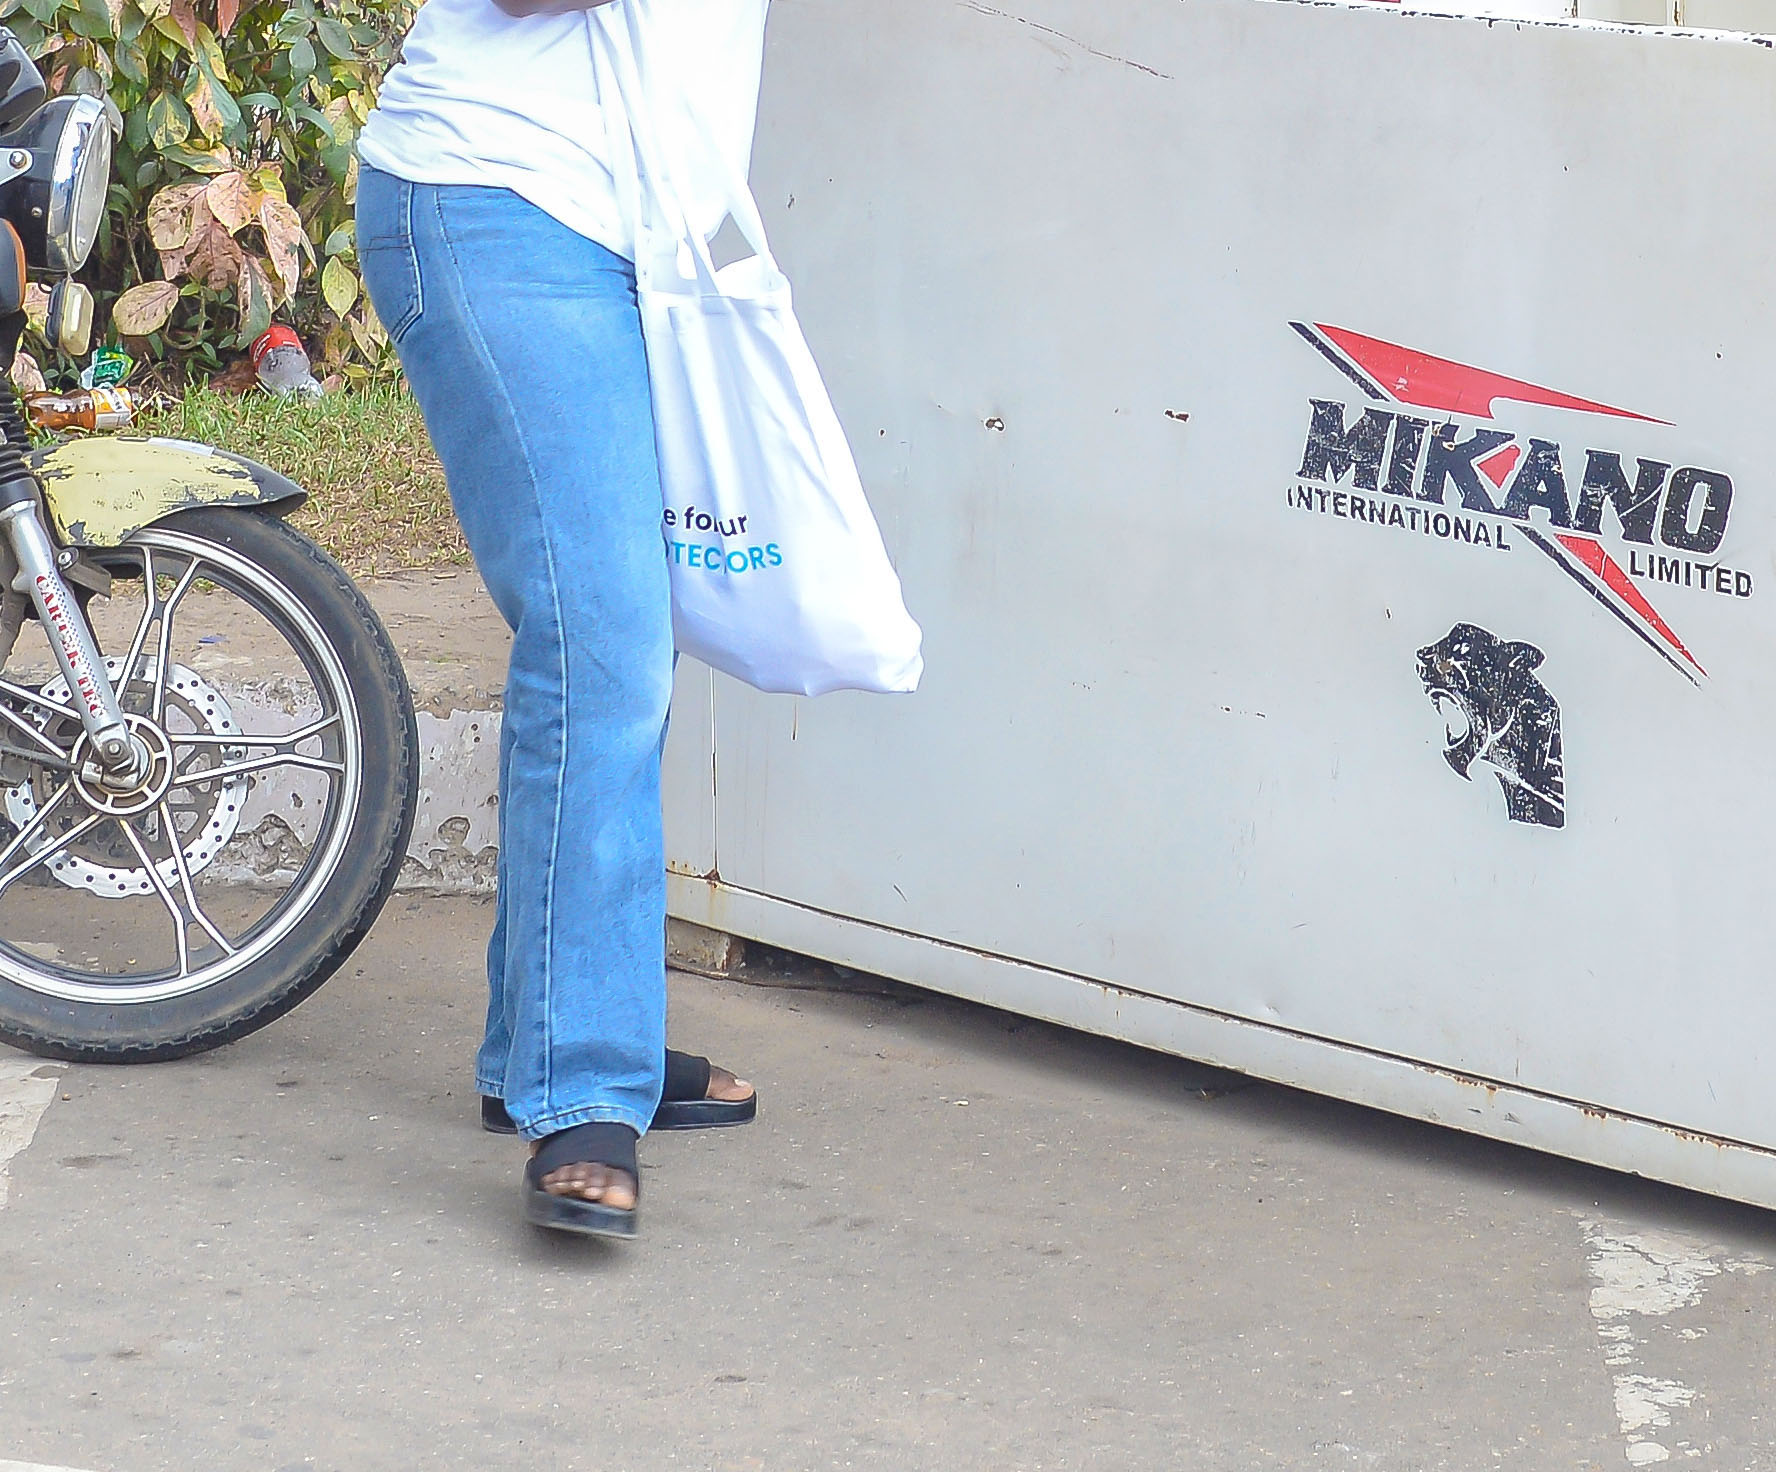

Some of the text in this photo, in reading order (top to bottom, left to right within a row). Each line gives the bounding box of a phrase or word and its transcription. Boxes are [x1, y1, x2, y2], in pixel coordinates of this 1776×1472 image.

[1295, 397, 1735, 556] MIKANO
[1286, 485, 1514, 553] INTERNATIONAL
[1627, 549, 1754, 599] LIMITED
